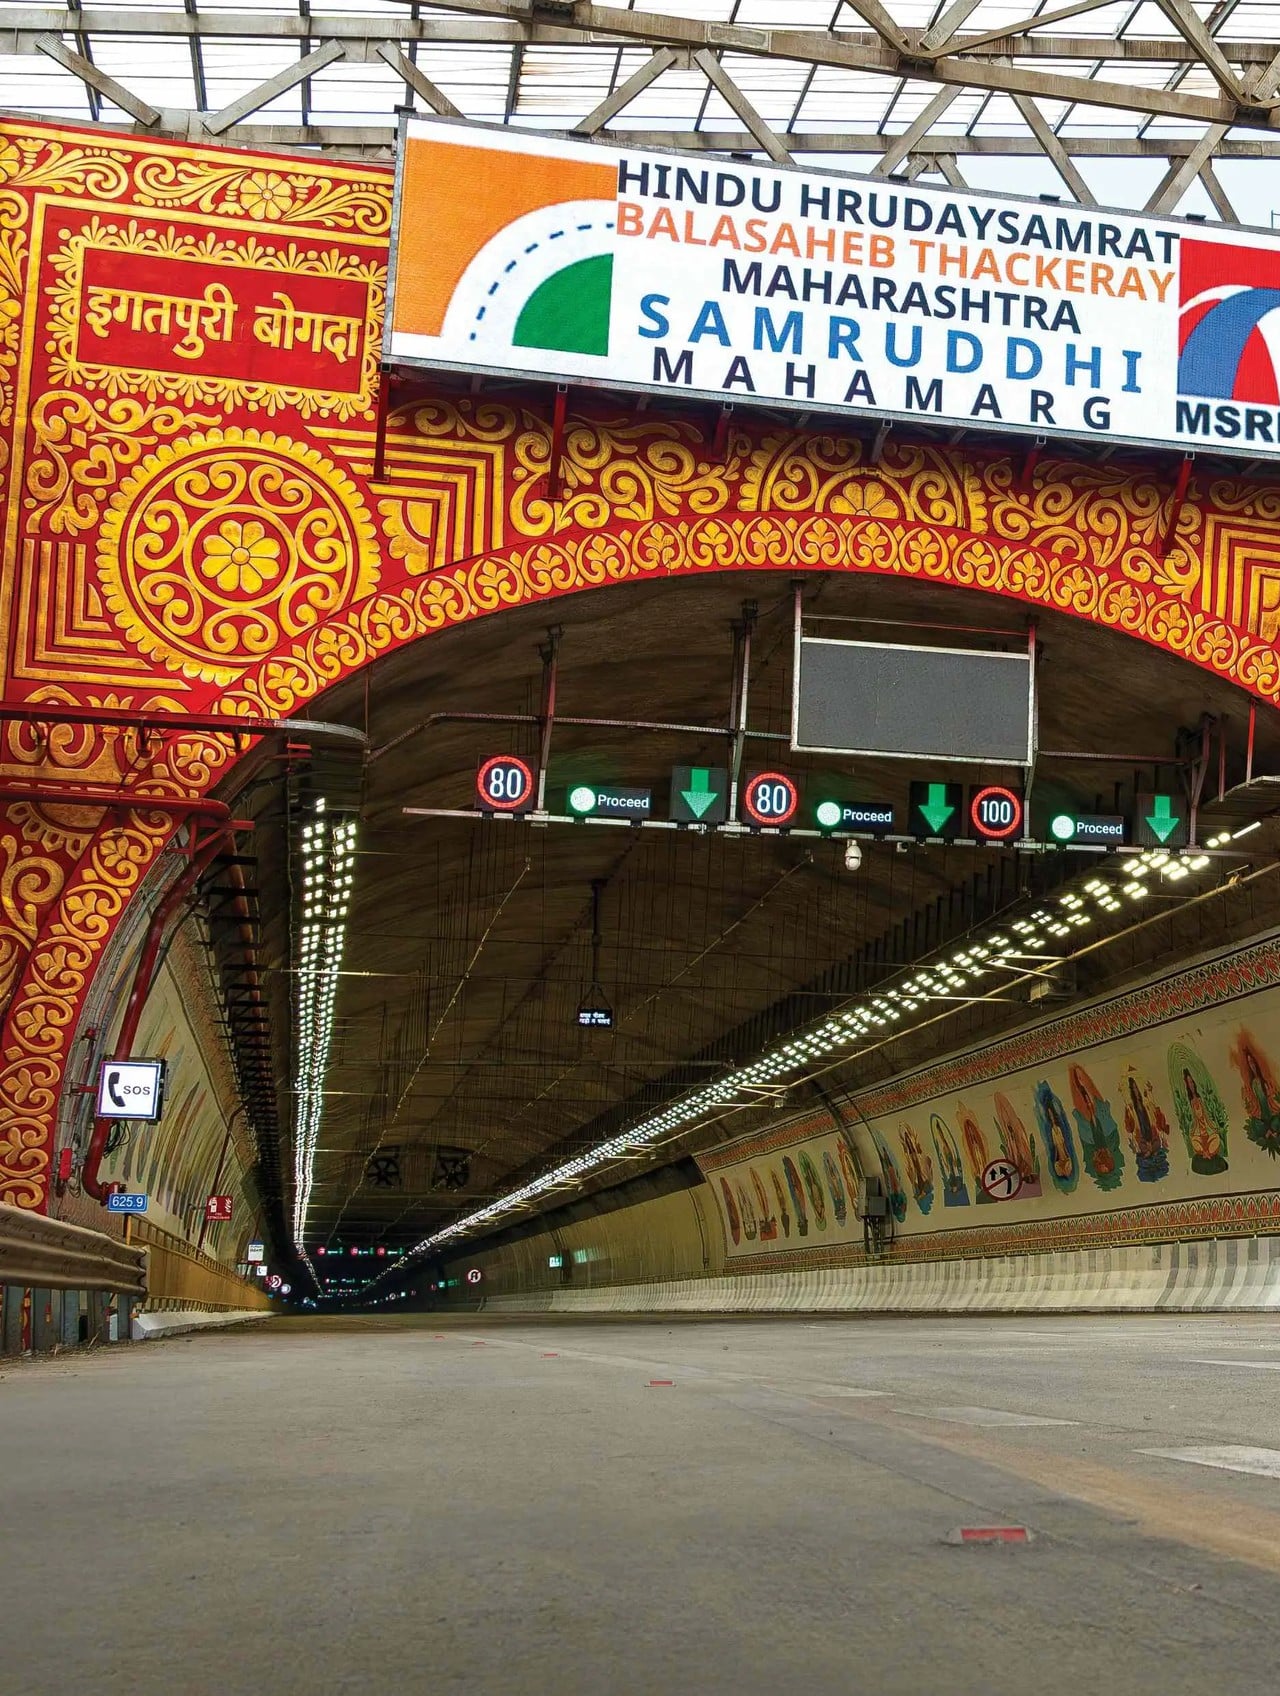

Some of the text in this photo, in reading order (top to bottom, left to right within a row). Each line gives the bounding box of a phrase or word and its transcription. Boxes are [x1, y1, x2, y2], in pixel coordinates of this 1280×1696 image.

[618, 159, 1180, 264] HINDU HRUDAYSAMRAT
[616, 201, 1176, 303] BALASAHEB THACKERAY
[722, 258, 1081, 334] MAHARASHTRA
[85, 282, 362, 363] इगतपुरी बोगदा
[638, 293, 1142, 394] SAMRUDDHI
[652, 347, 1111, 430] MAHAMARG
[489, 767, 522, 799] 80
[756, 783, 787, 814] 80
[597, 793, 649, 809] Proceed
[843, 808, 892, 823] Proceed
[981, 800, 1011, 824] 100
[1076, 821, 1123, 835] Proceed
[123, 1085, 151, 1096] SOS
[112, 1196, 144, 1208] 625.9
